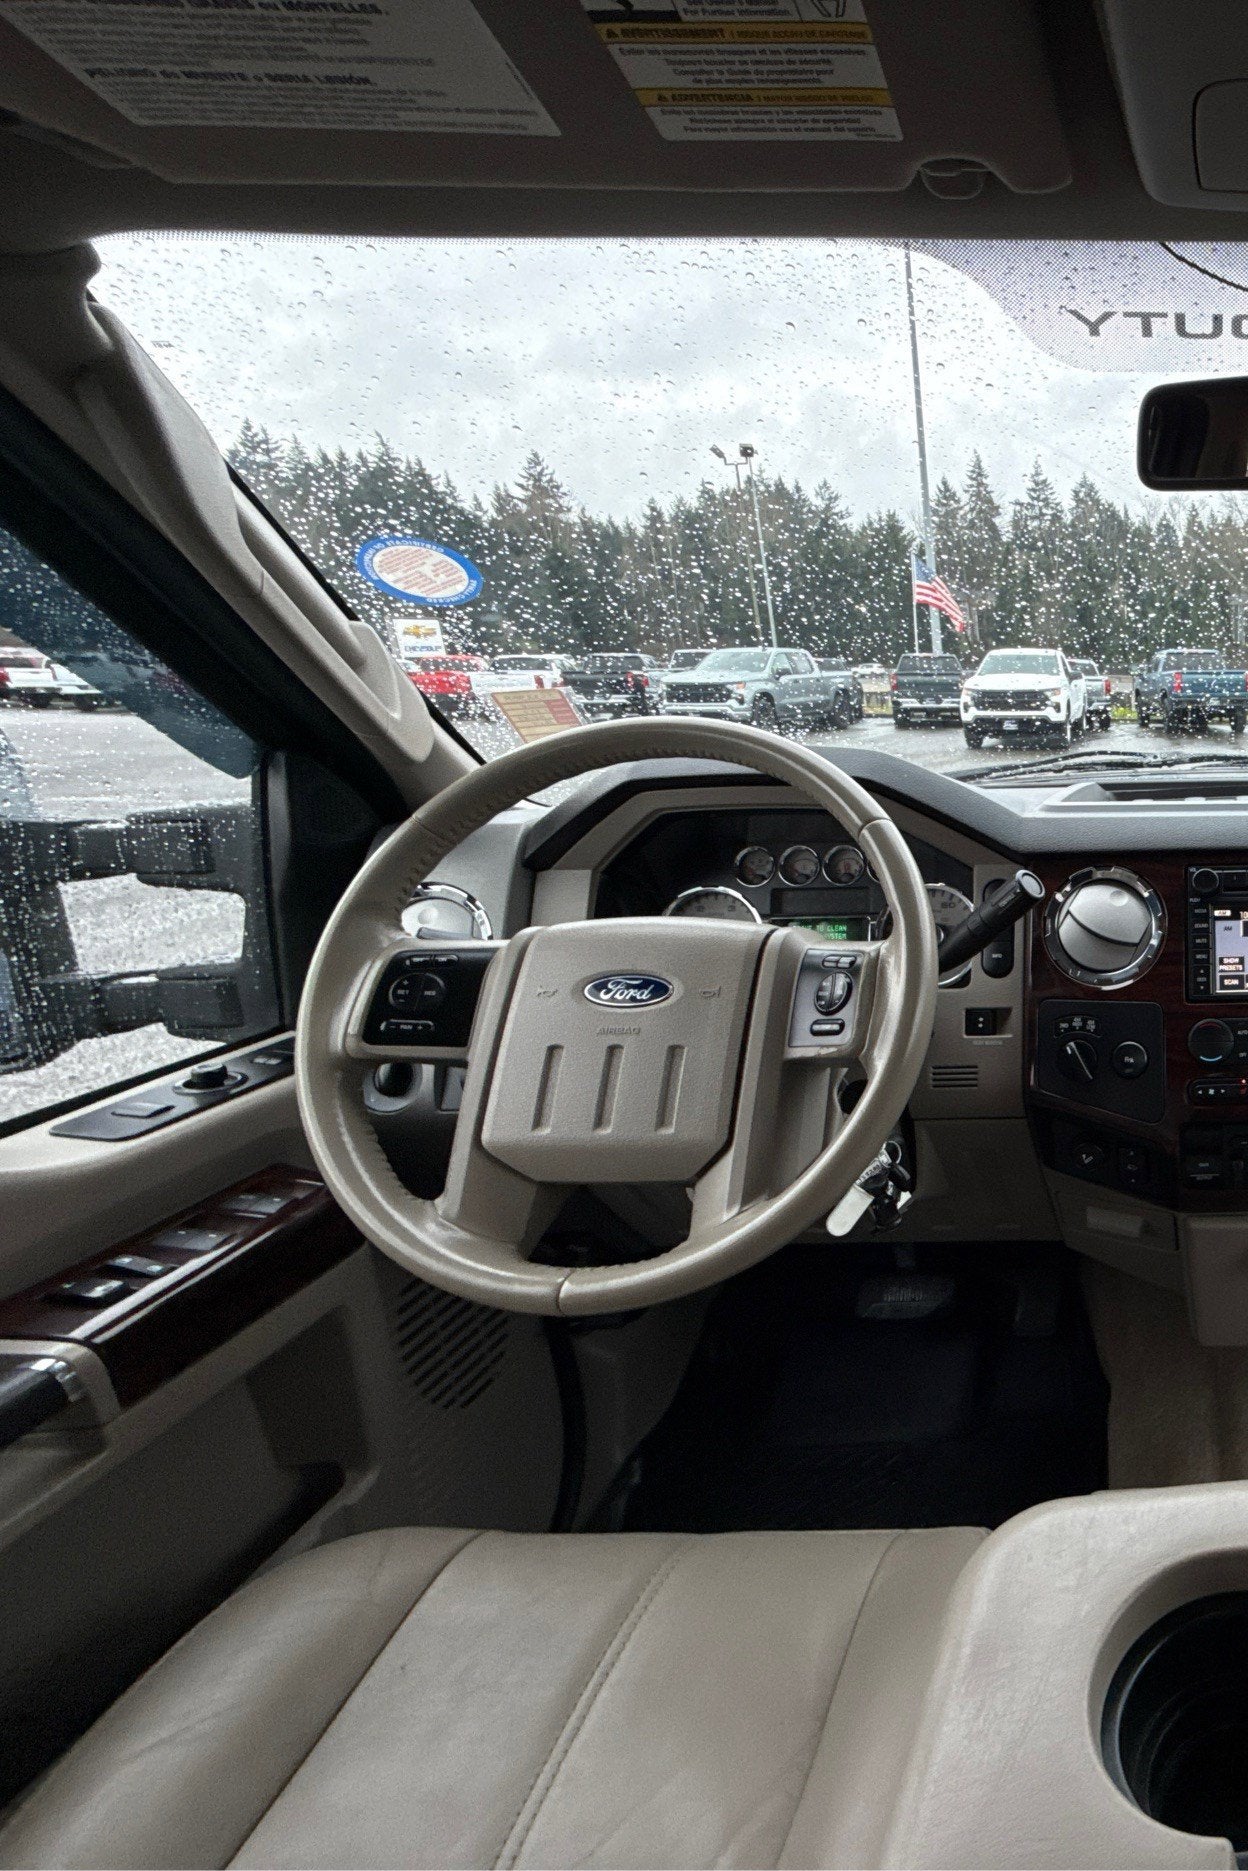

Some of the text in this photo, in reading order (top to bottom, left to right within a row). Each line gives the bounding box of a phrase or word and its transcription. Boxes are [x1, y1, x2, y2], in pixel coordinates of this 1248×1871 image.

[826, 924, 848, 932] CLEAN
[1223, 957, 1241, 965] SHOW
[1219, 964, 1243, 972] PRESETS
[1223, 978, 1240, 986] SCAN
[599, 978, 654, 1001] Ford
